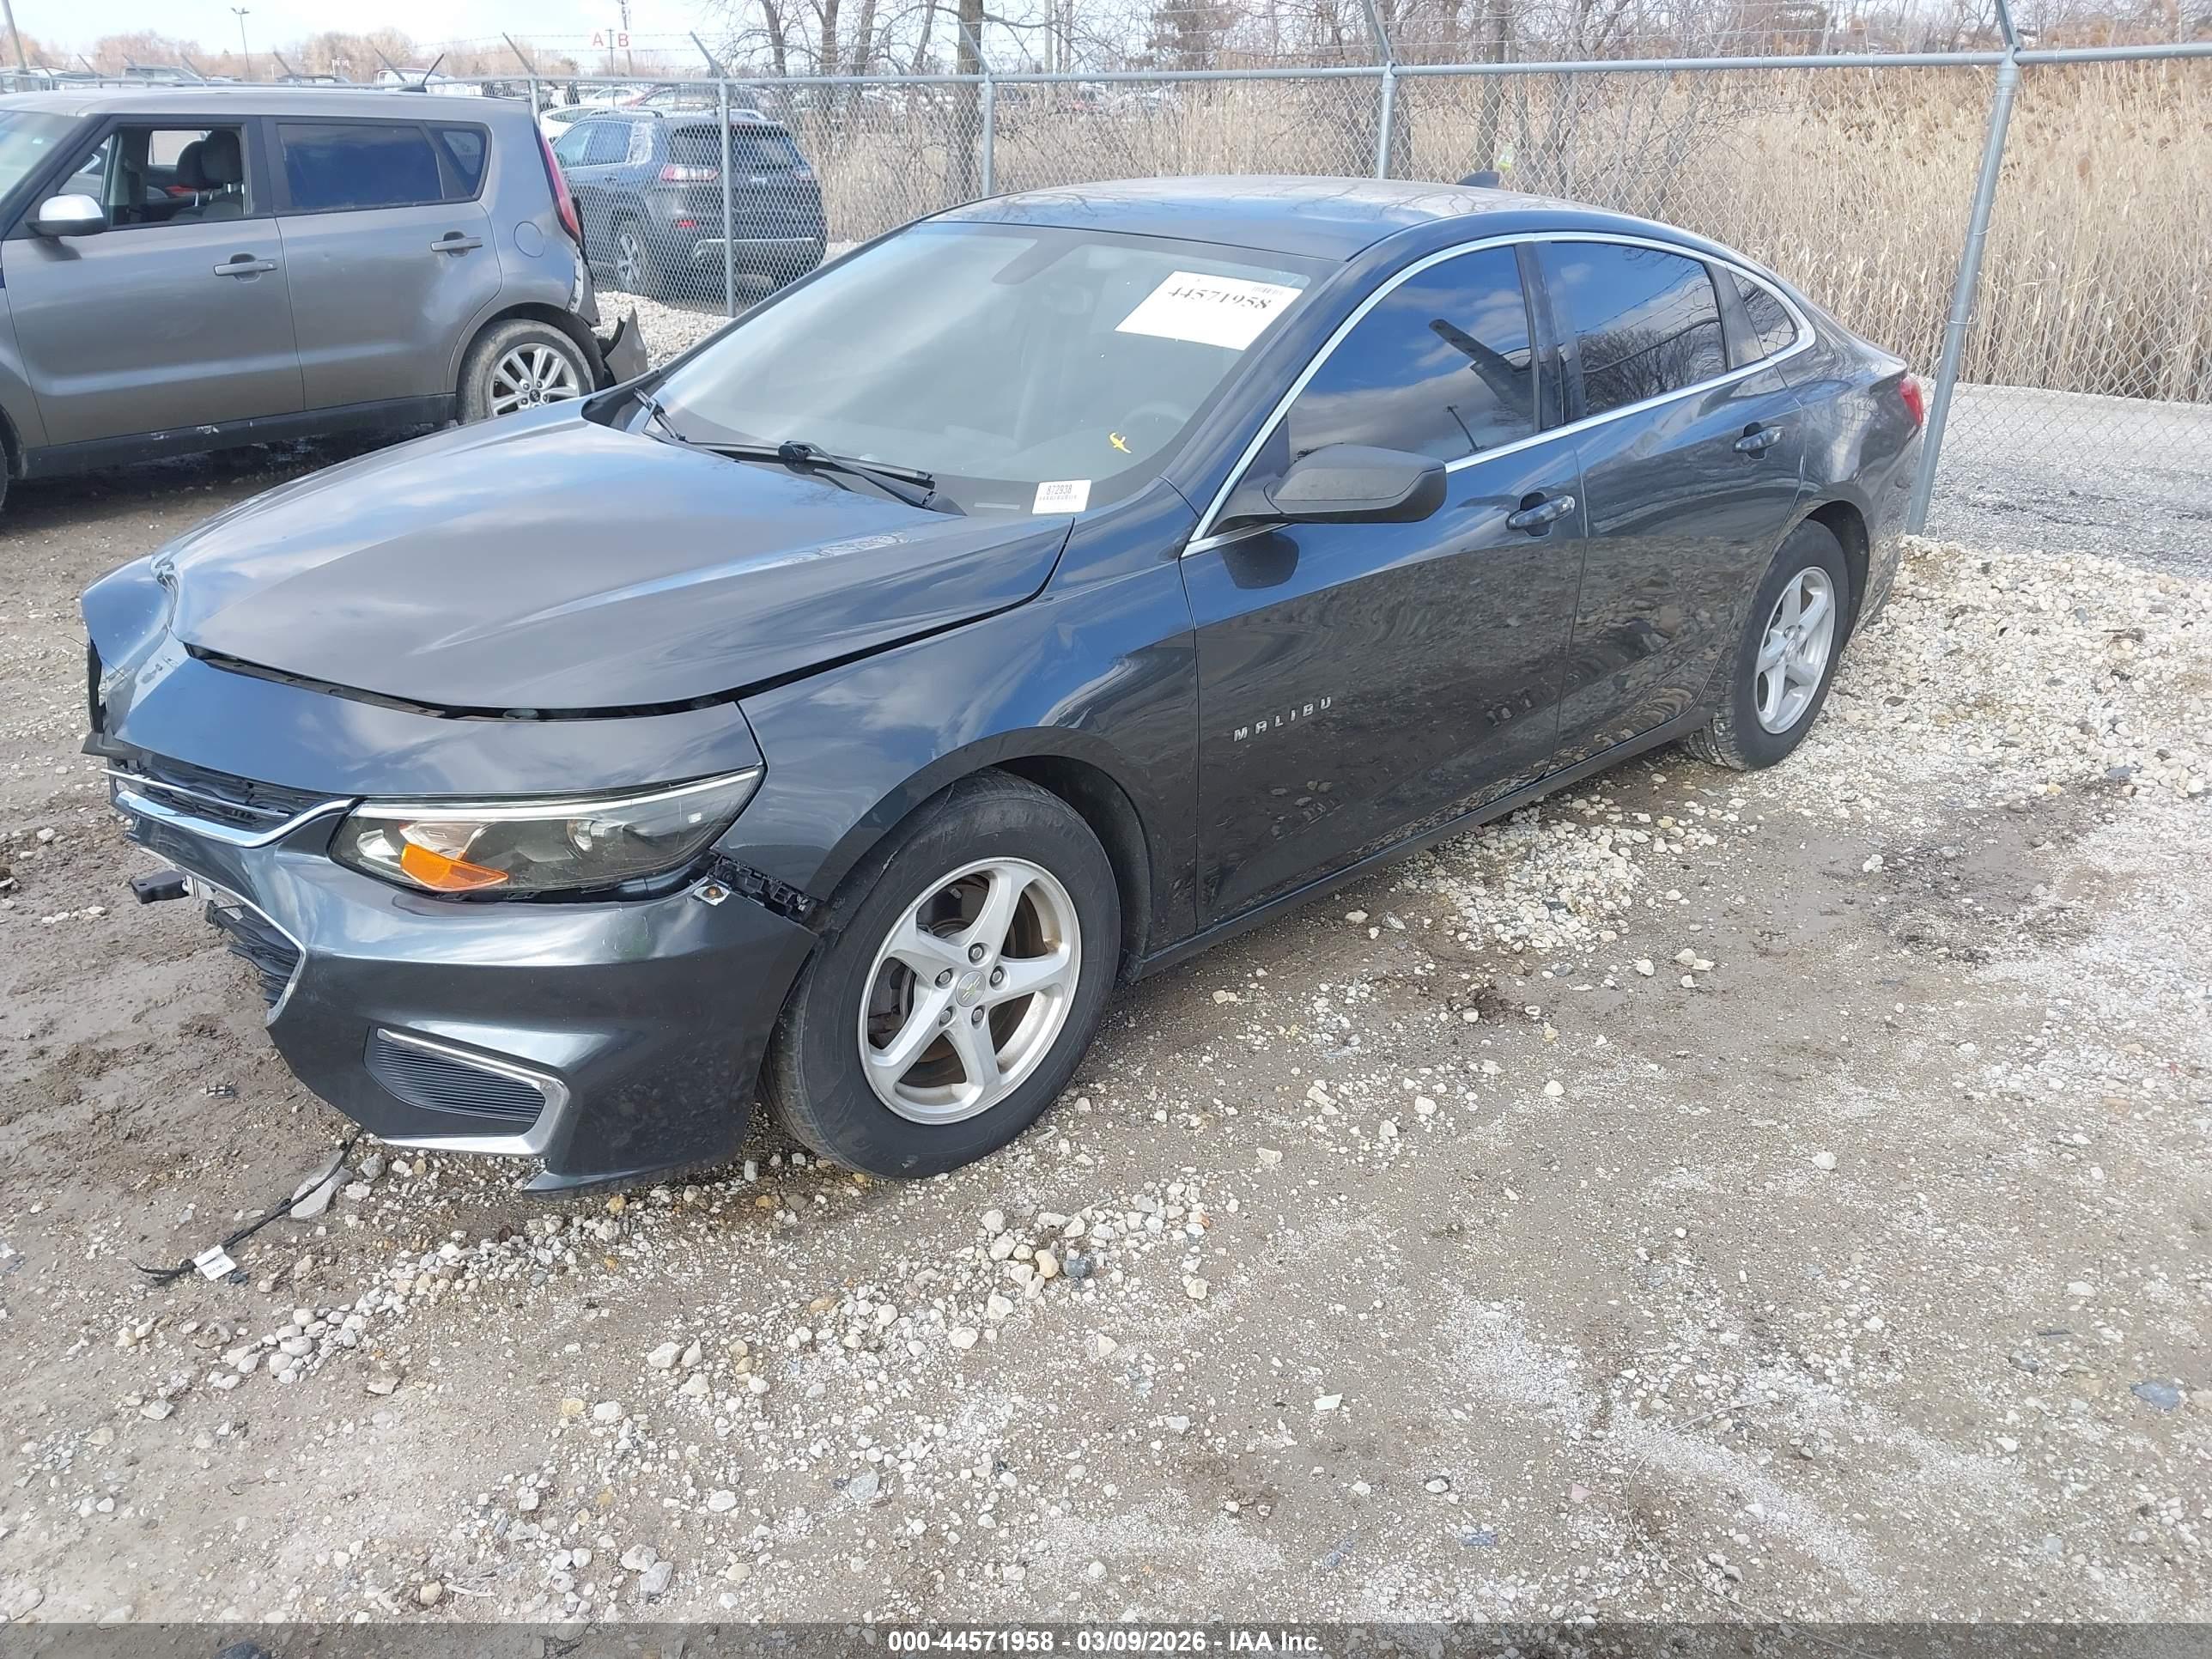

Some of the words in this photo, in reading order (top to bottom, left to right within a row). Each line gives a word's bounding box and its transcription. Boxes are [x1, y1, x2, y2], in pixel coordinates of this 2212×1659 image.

[592, 32, 604, 46] A
[617, 33, 629, 47] B
[1167, 286, 1272, 310] 44571958
[1233, 696, 1332, 742] MALIBU
